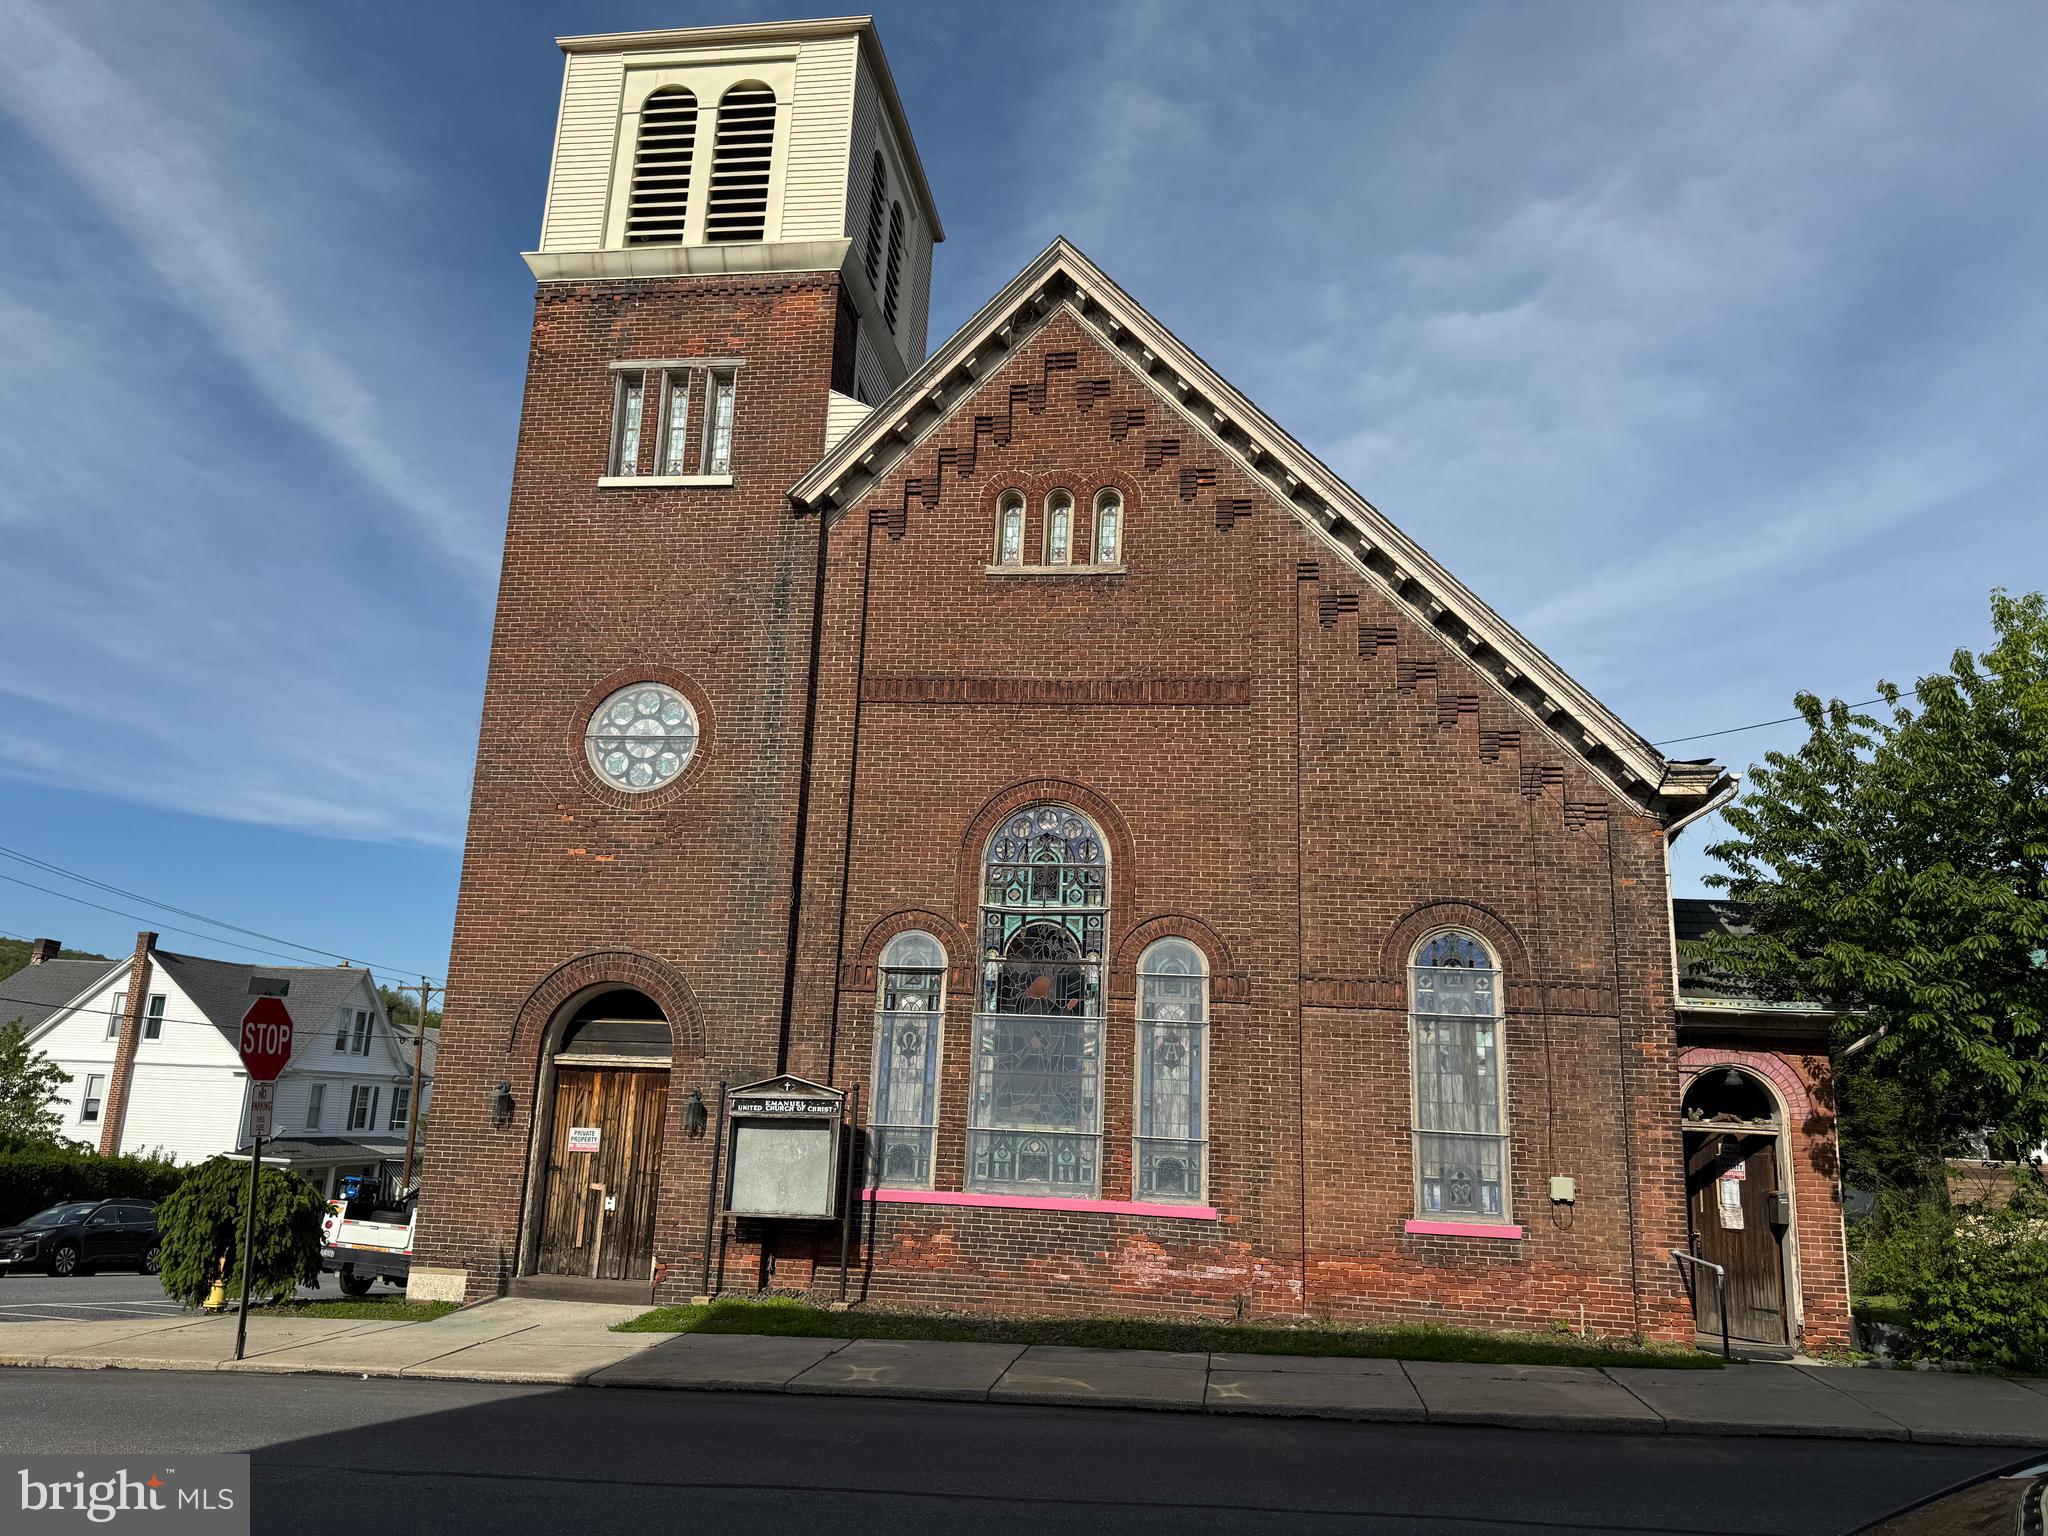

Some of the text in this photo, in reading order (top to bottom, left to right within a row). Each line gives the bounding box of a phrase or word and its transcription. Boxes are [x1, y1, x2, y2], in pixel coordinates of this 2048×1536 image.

[243, 1022, 290, 1055] STOP
[258, 1089, 267, 1099] NO
[252, 1101, 272, 1111] PARKING
